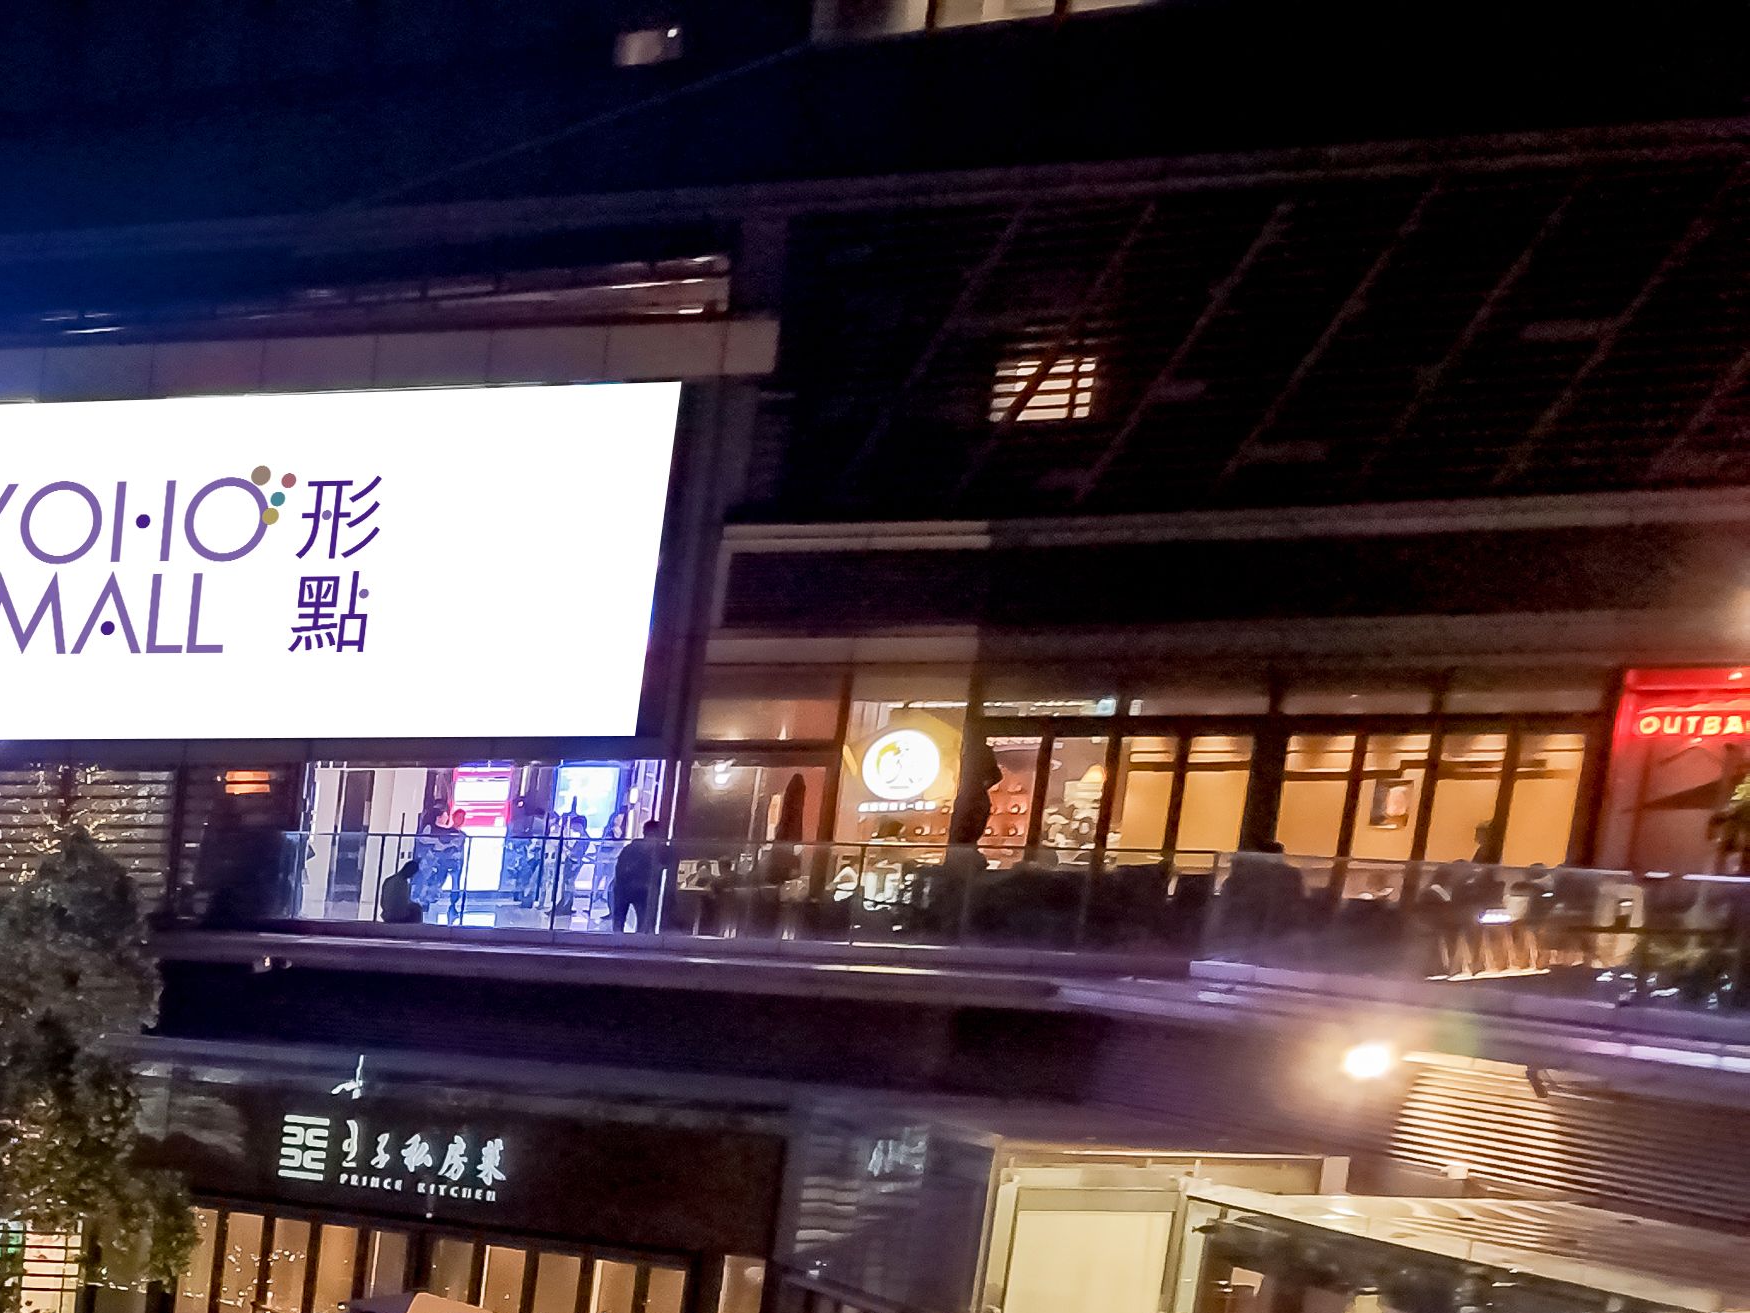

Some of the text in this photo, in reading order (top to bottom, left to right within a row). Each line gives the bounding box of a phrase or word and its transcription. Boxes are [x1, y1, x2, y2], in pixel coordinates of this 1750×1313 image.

[1639, 715, 1750, 735] OUTBA
[340, 1173, 497, 1202] PRINCE KITCHEN
